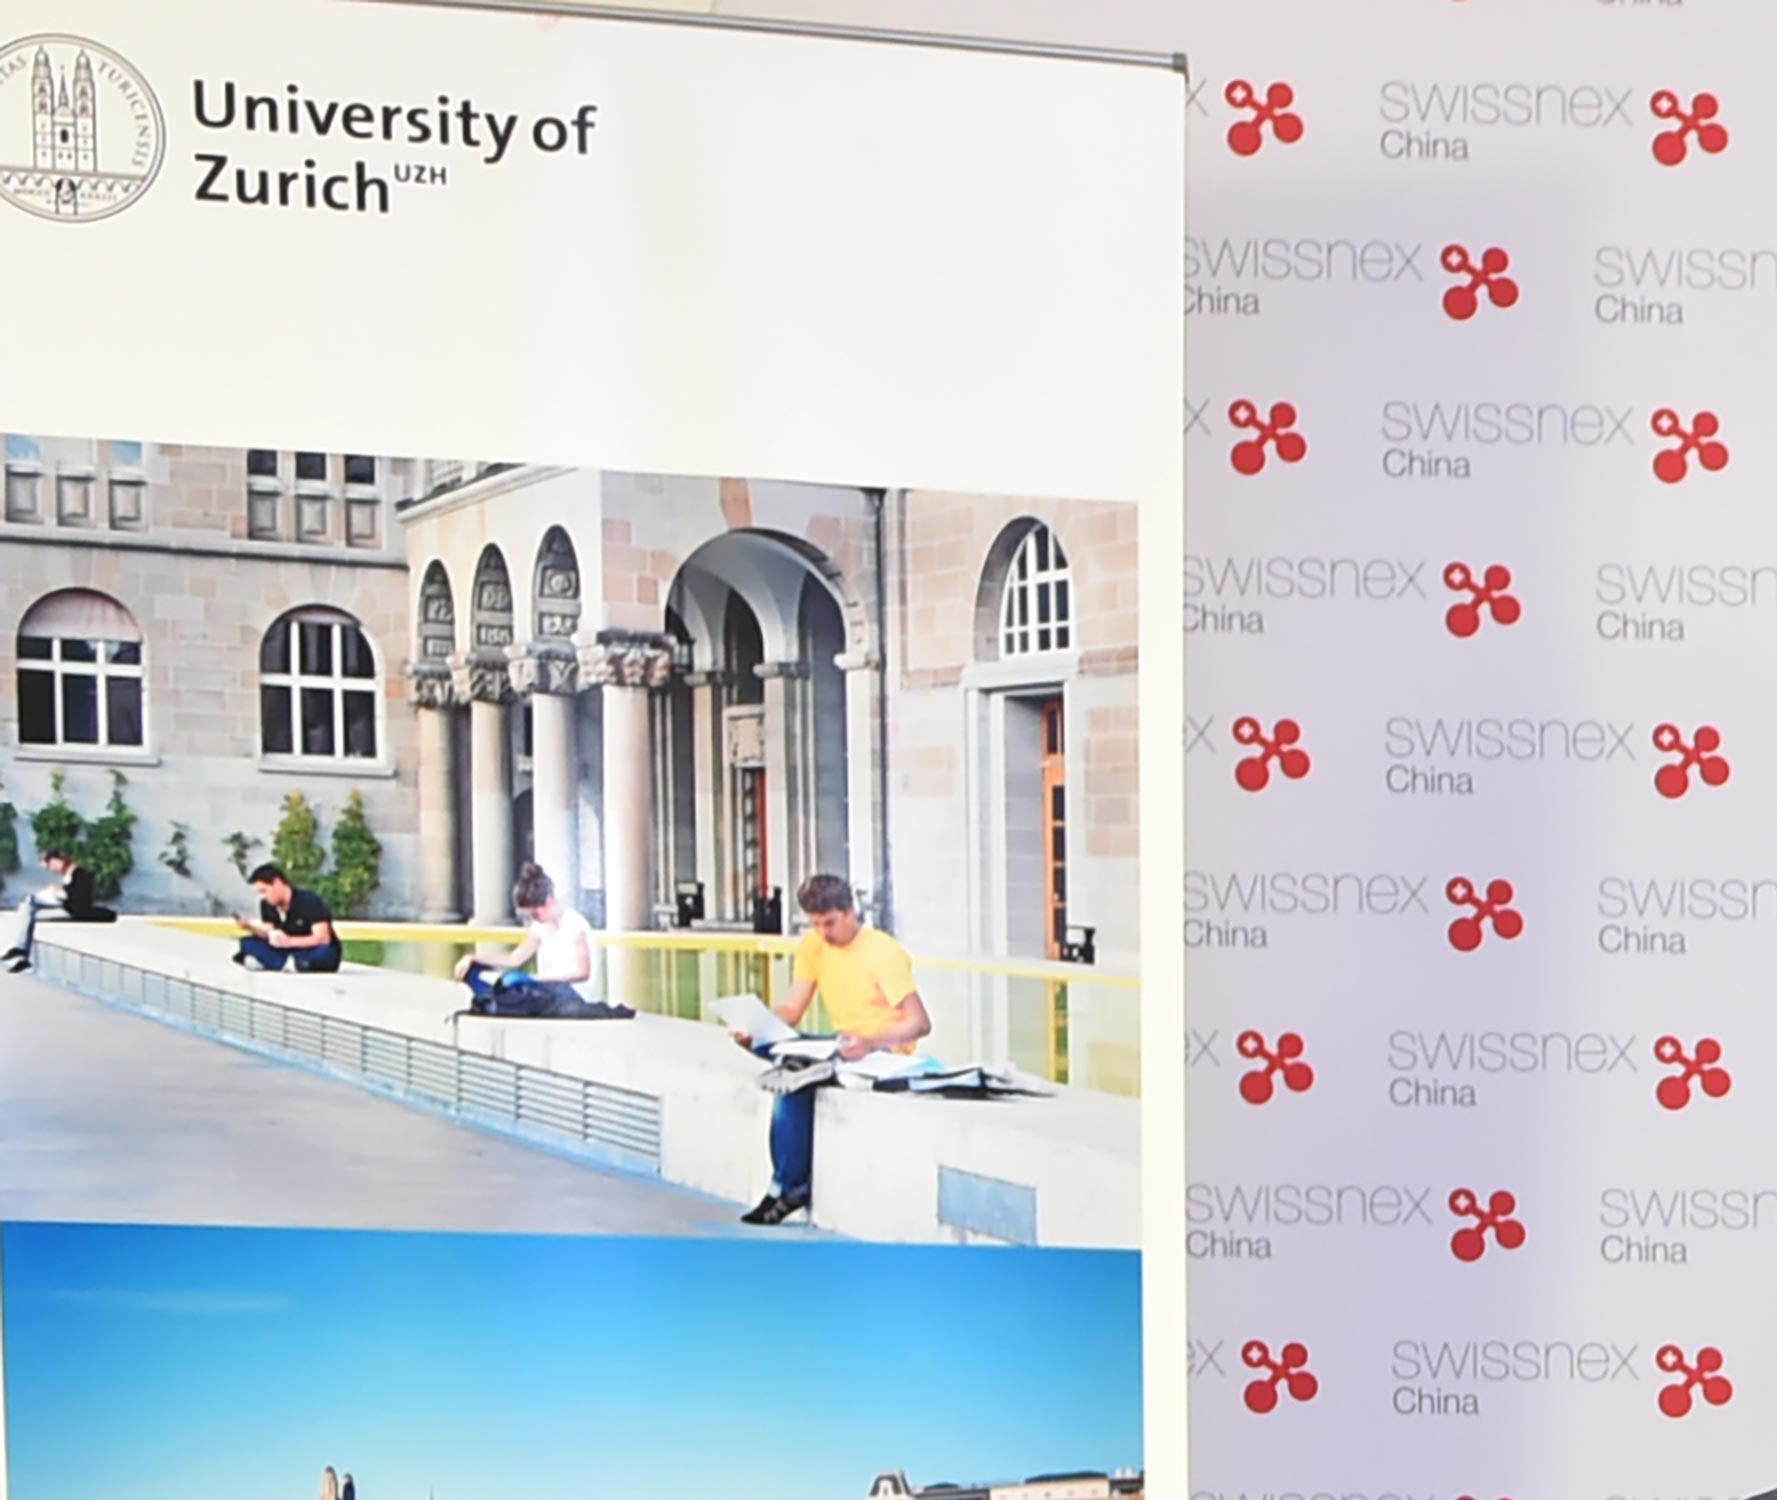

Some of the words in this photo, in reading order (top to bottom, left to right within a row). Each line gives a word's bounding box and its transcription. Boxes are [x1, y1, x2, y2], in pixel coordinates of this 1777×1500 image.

[1380, 81, 1632, 127] swissnex
[194, 80, 518, 164] University
[533, 105, 598, 154] of
[1380, 128, 1469, 161] China
[194, 153, 389, 212] Zurich
[394, 164, 447, 185] UZH
[1594, 293, 1684, 325] China
[1383, 400, 1634, 445] swissnex
[1382, 447, 1471, 479] China
[1596, 610, 1685, 642] China
[1386, 717, 1636, 761] swissnex
[1385, 764, 1474, 796] China
[1598, 924, 1686, 955] China
[1389, 1030, 1637, 1073] swissnex
[1388, 1076, 1477, 1108] China
[1182, 1182, 1429, 1224] swissnex
[1185, 1229, 1272, 1260] China
[1600, 1234, 1688, 1264] China
[1392, 1340, 1639, 1381] swissnex
[1392, 1385, 1479, 1416] China
